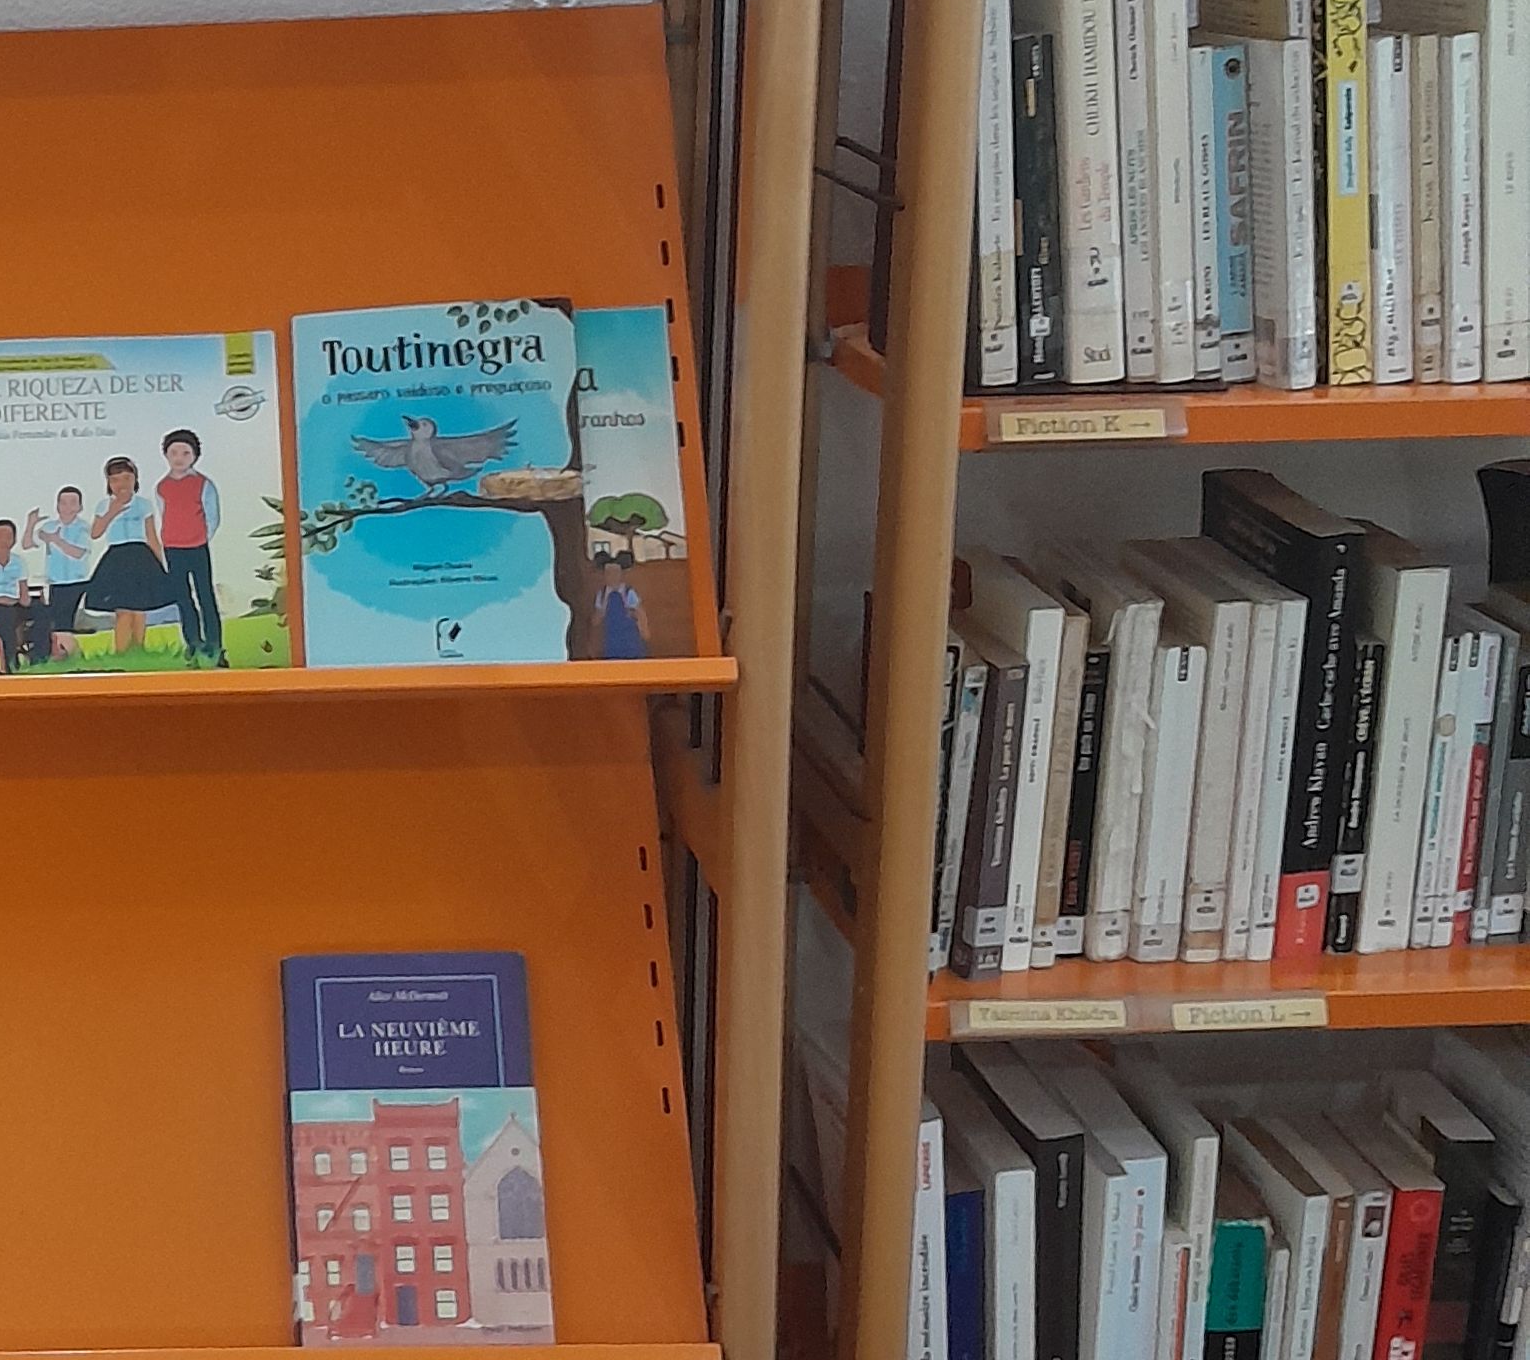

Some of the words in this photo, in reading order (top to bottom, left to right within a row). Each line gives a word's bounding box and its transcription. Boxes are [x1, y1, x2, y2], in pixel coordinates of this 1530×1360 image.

[323, 333, 546, 376] Toutinegra
[7, 377, 102, 399] RIQUEZA
[110, 376, 139, 393] DE
[143, 374, 185, 392] SER
[322, 394, 332, 405] o
[1015, 416, 1096, 436] Fiction
[1103, 415, 1121, 434] K
[1328, 567, 1348, 620] Amanda
[1306, 742, 1328, 796] Klavan
[1302, 796, 1322, 850] Andrew
[979, 1008, 1051, 1021] Yasmina
[1056, 1009, 1119, 1021] Khadra
[1189, 1008, 1265, 1024] Fiction
[1271, 1007, 1286, 1022] L
[338, 1021, 364, 1040] LA
[370, 1015, 481, 1039] NEUVIÈME
[373, 1039, 447, 1057] HEURE
